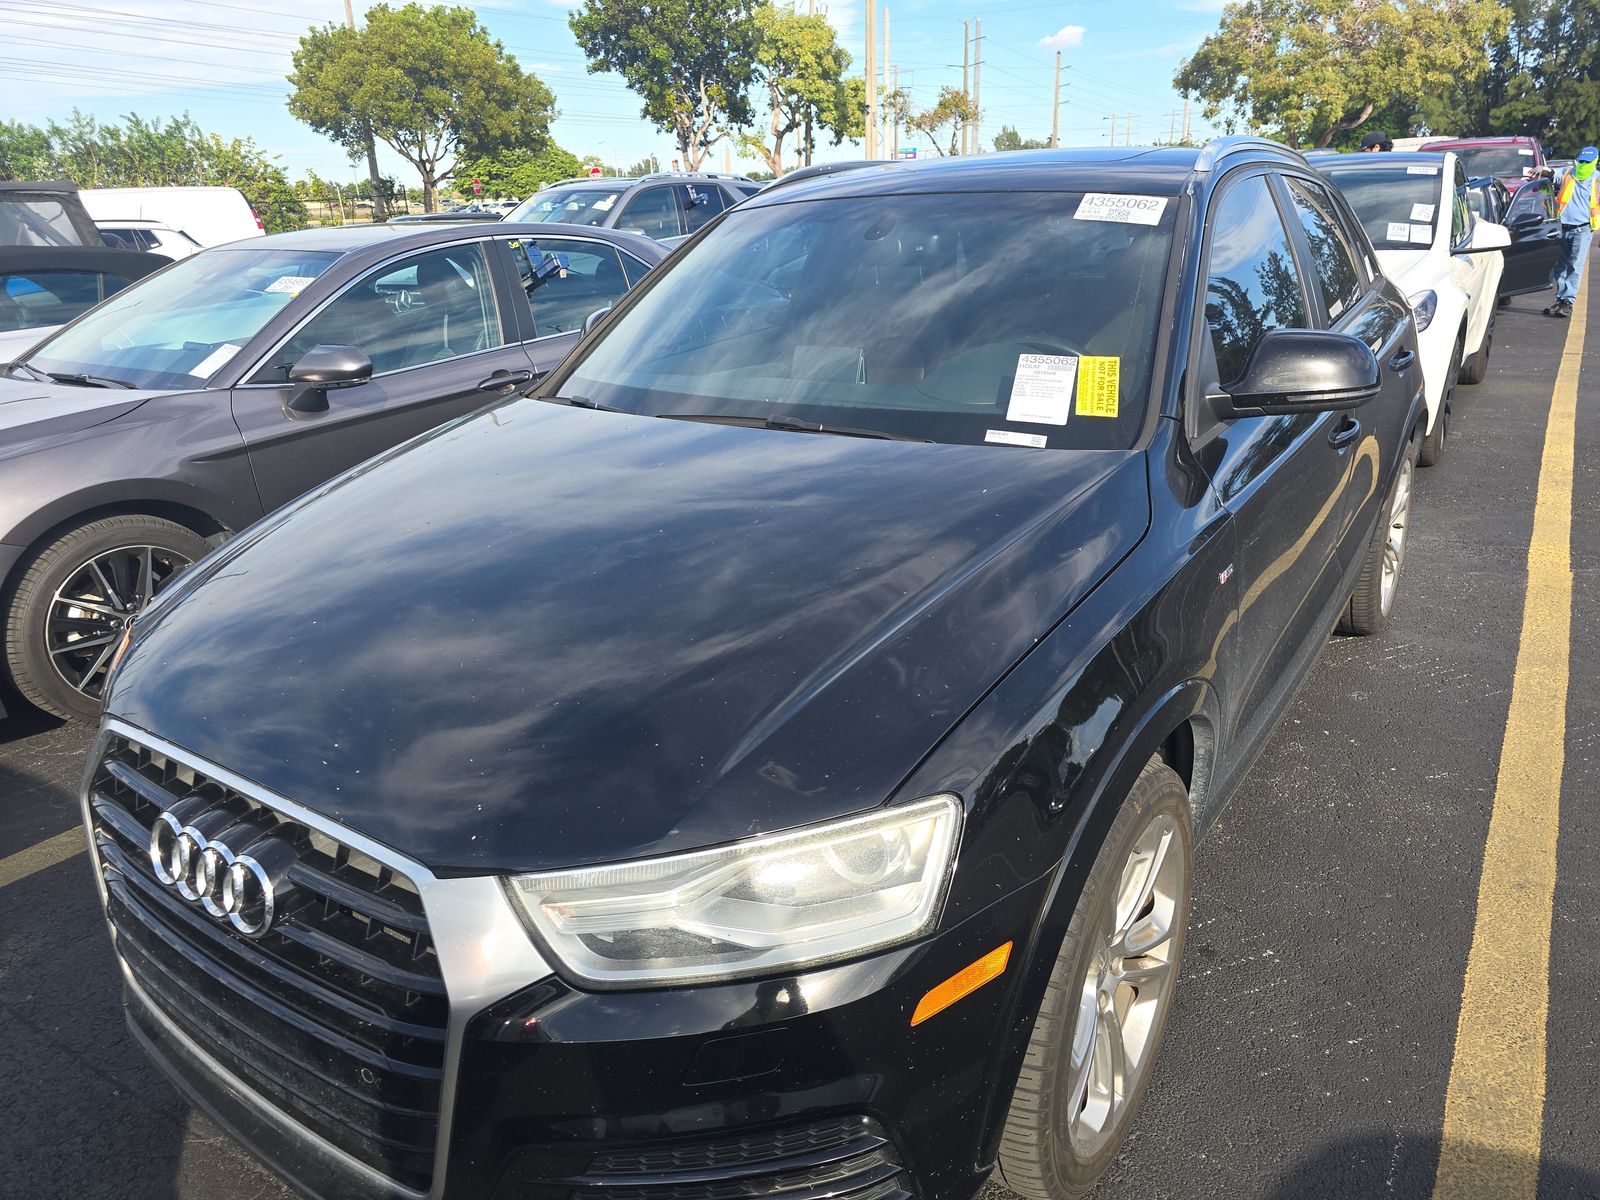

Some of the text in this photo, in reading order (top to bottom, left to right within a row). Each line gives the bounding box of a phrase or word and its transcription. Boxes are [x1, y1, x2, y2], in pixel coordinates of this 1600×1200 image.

[1084, 196, 1159, 211] 4355062
[1022, 355, 1077, 366] 4355062
[1096, 361, 1106, 411] NOT FOR SALE
[1105, 360, 1117, 414] THIS VEHICLE
